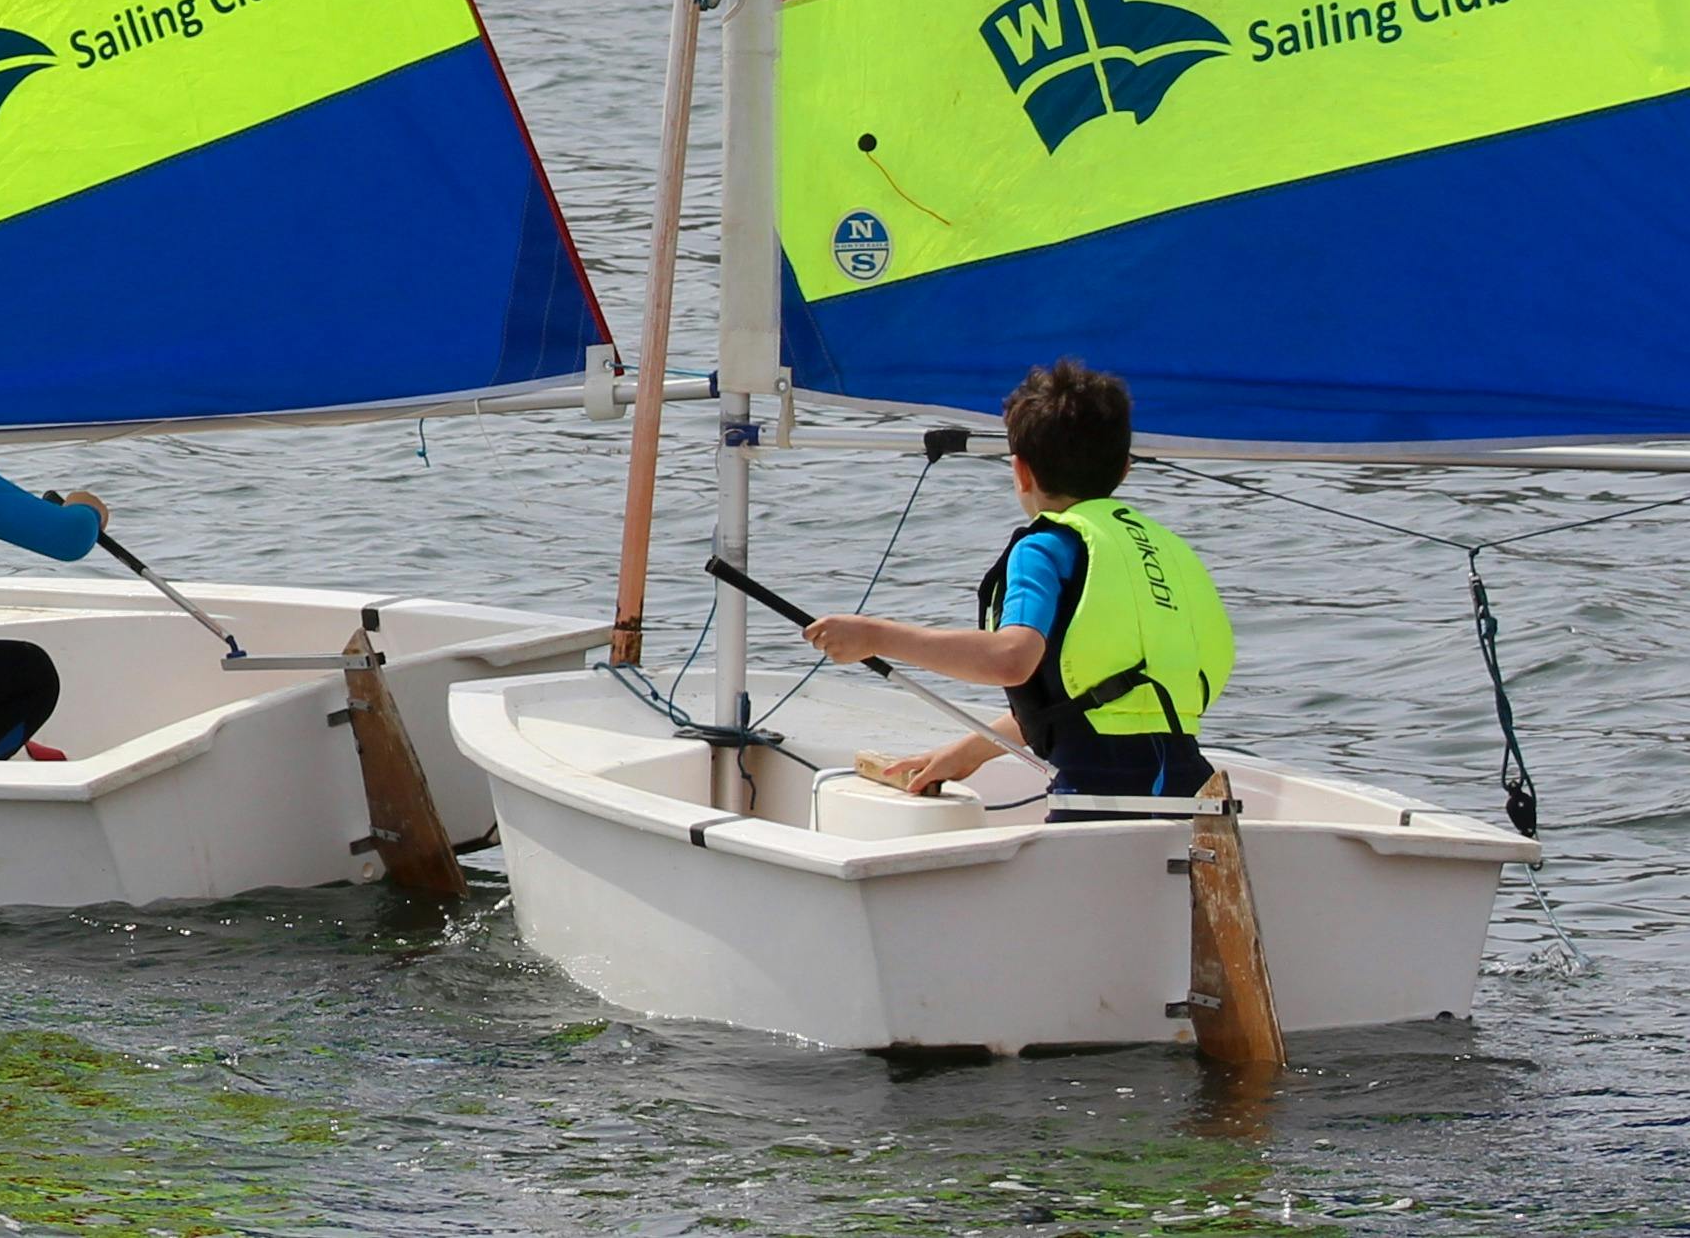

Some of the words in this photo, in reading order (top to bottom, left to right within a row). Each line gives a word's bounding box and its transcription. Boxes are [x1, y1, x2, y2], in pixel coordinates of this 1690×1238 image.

[848, 219, 874, 239] N
[852, 253, 876, 272] S
[1112, 508, 1178, 611] Vaikobi
